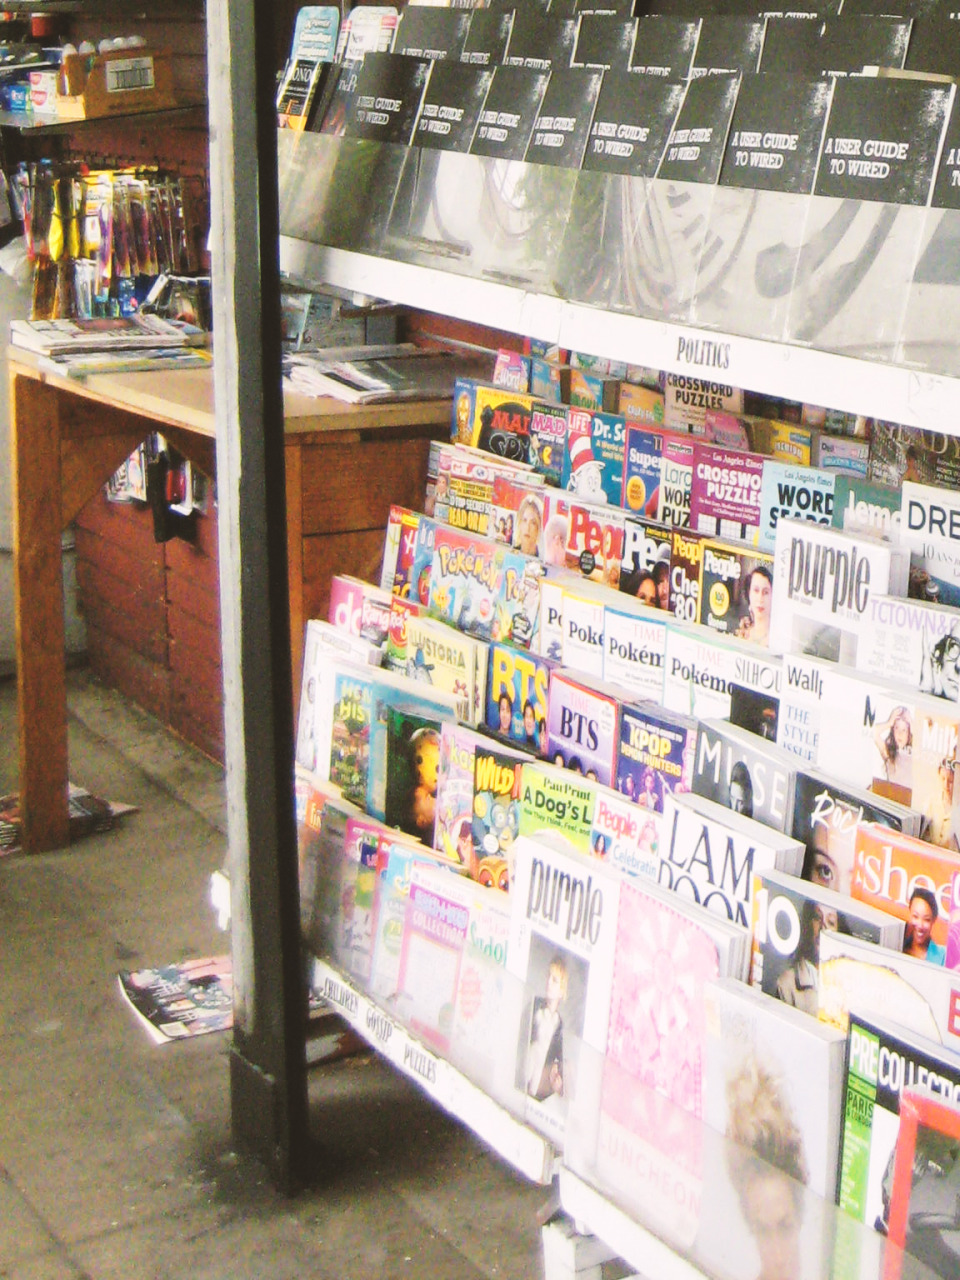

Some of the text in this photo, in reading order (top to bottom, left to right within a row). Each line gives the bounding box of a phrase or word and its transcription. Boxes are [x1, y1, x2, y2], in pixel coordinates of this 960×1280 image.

[617, 124, 650, 142] GUIDE
[689, 128, 713, 143] GUIDE
[740, 132, 799, 150] USER GUIDE
[604, 141, 634, 157] WIRED
[736, 152, 784, 169] TO WIRED
[824, 138, 909, 161] A USER GUIDE
[947, 148, 956, 165] A
[830, 160, 890, 179] TO WIRED
[676, 336, 731, 369] POLITICS
[668, 373, 733, 398] CROSSWORD
[675, 389, 723, 411] PUZZLES
[532, 412, 566, 437] MAD
[568, 412, 590, 432] LIFE
[593, 417, 613, 440] Dr.
[724, 455, 744, 467] Angeles
[795, 472, 816, 484] Angeles
[439, 543, 498, 593] Pokémon
[705, 549, 742, 581] People
[788, 536, 871, 614] purple
[491, 647, 548, 721] BTS
[786, 704, 810, 725] THE
[560, 705, 599, 752] BTS
[784, 723, 818, 747] STYLE
[630, 724, 672, 758] KPOP
[643, 752, 682, 777] HUNTERS
[523, 786, 532, 805] A
[527, 856, 603, 946] purple
[366, 1007, 392, 1043] GOSSIP
[403, 1042, 437, 1084] PUZZLES
